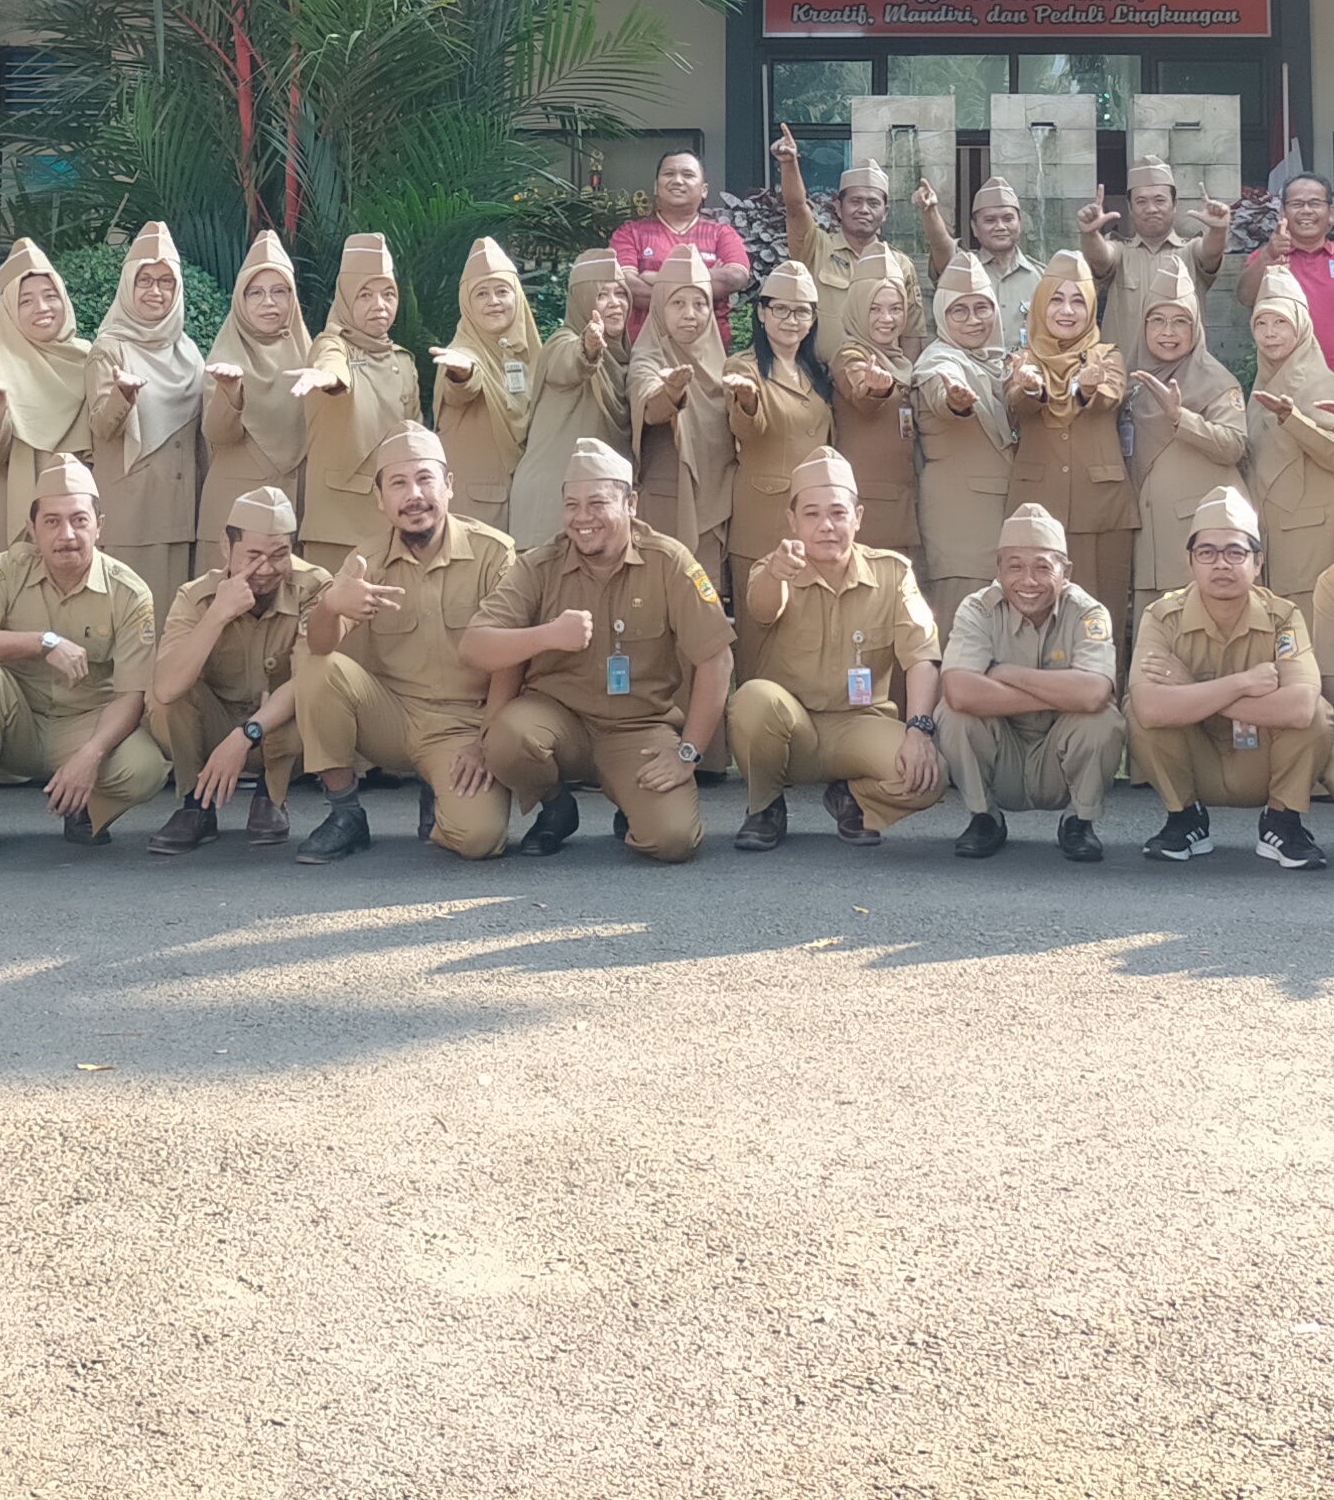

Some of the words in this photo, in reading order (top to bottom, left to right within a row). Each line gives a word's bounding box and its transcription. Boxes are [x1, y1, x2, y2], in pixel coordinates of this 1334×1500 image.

[792, 4, 875, 25] Kreatif,
[883, 4, 979, 25] Mandiri,
[986, 4, 1027, 24] dan
[1034, 4, 1105, 24] Peduli
[1111, 4, 1240, 28] Lingkungan
